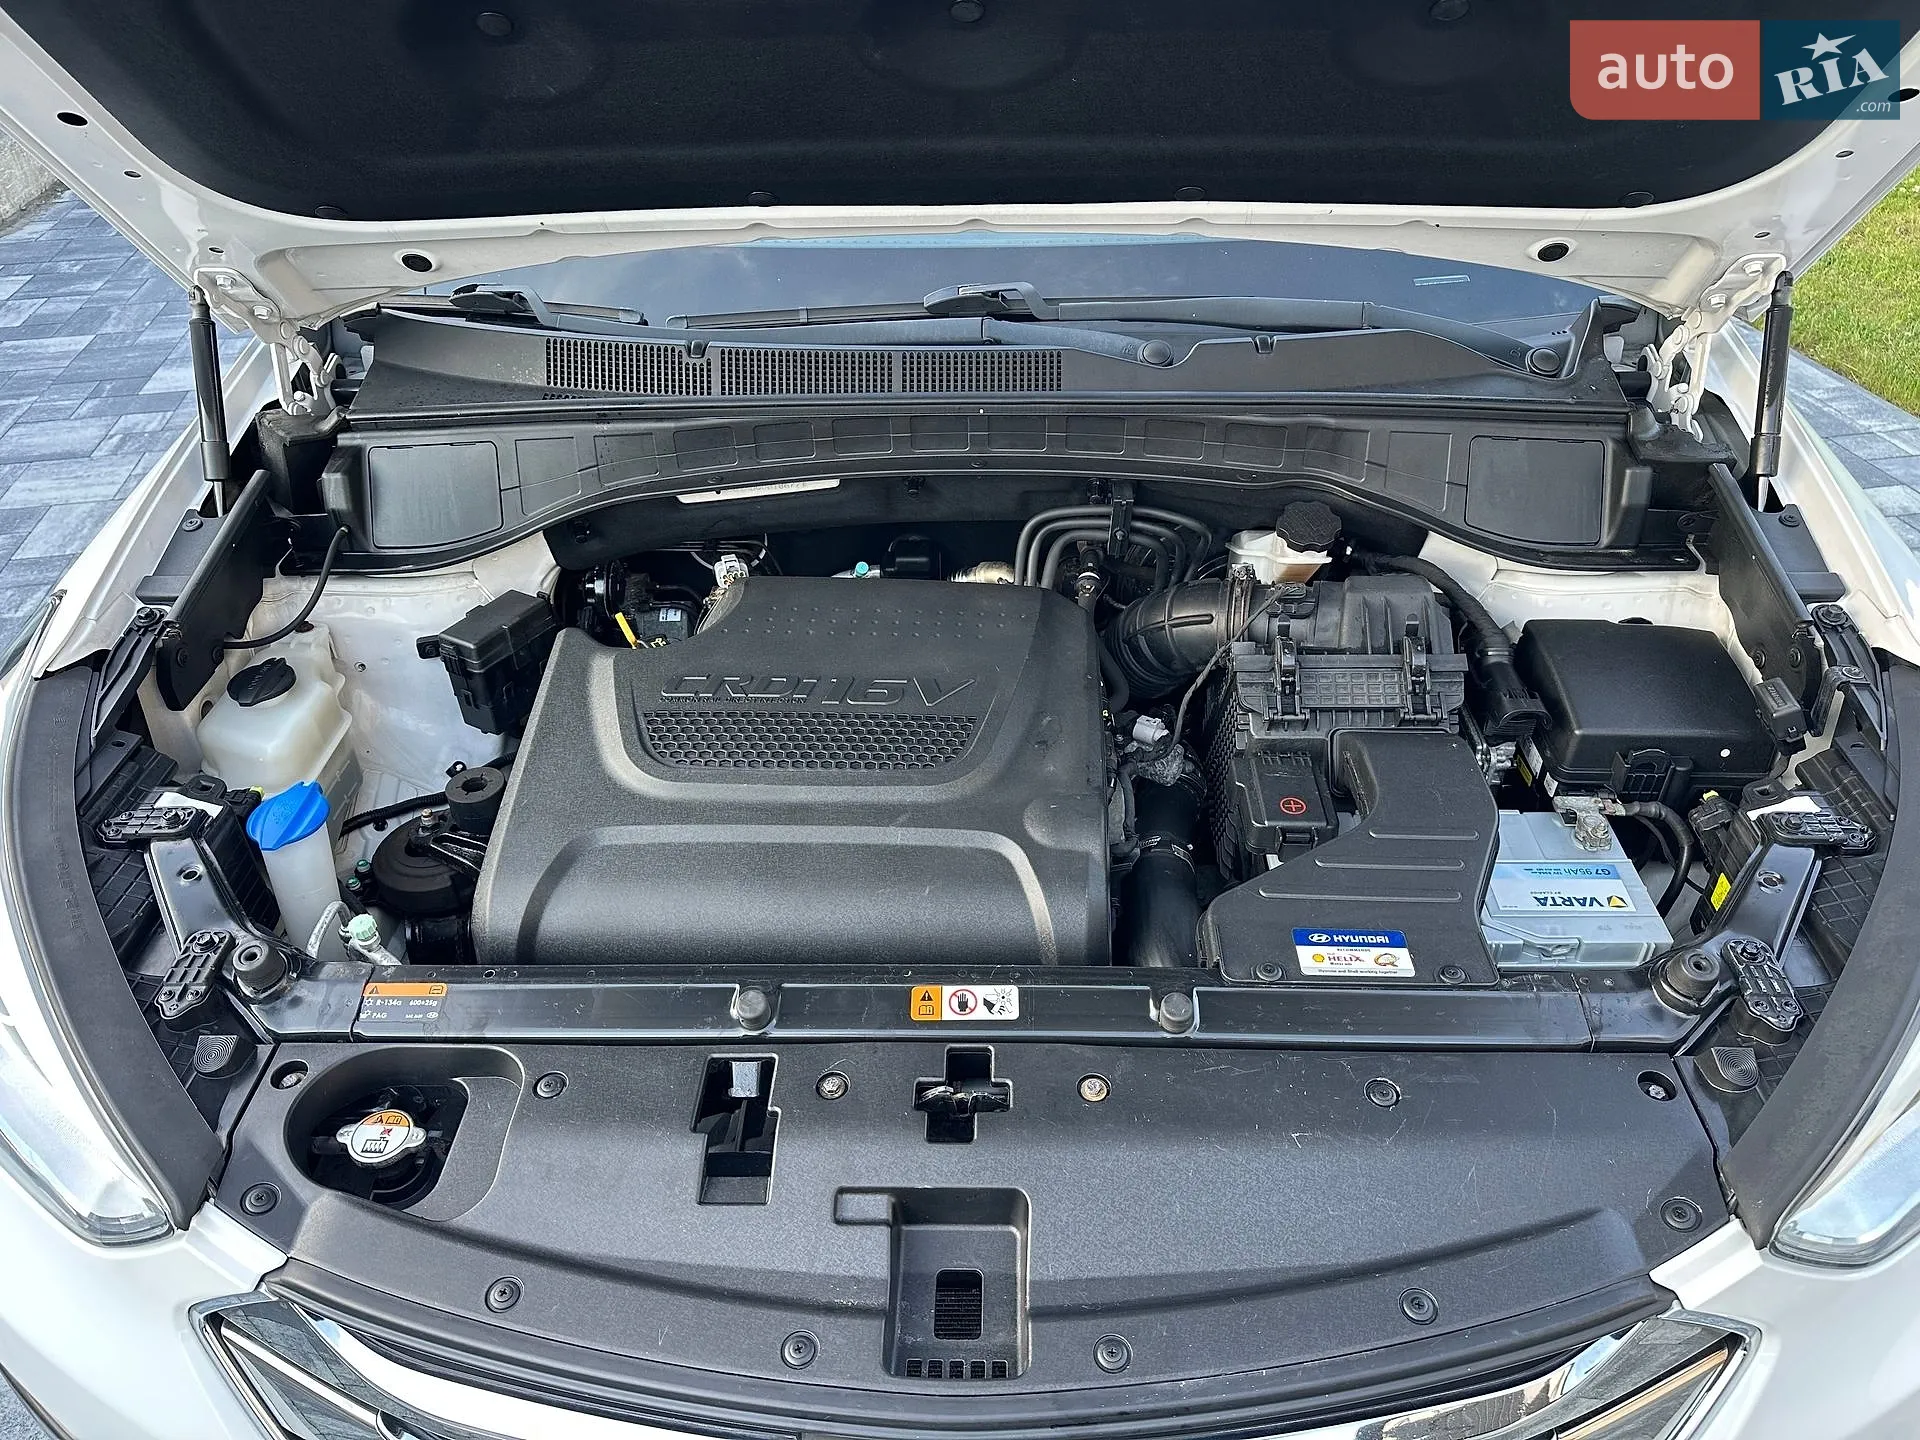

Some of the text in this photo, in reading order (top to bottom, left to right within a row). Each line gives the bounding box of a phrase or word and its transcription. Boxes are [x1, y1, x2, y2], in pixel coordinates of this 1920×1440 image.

[821, 676, 978, 706] 16V
[1563, 867, 1593, 876] 95Ah
[1595, 868, 1611, 876] G7
[1532, 895, 1604, 908] VARTA
[1333, 935, 1390, 944] HYUNDAI
[1328, 954, 1364, 962] HELIX
